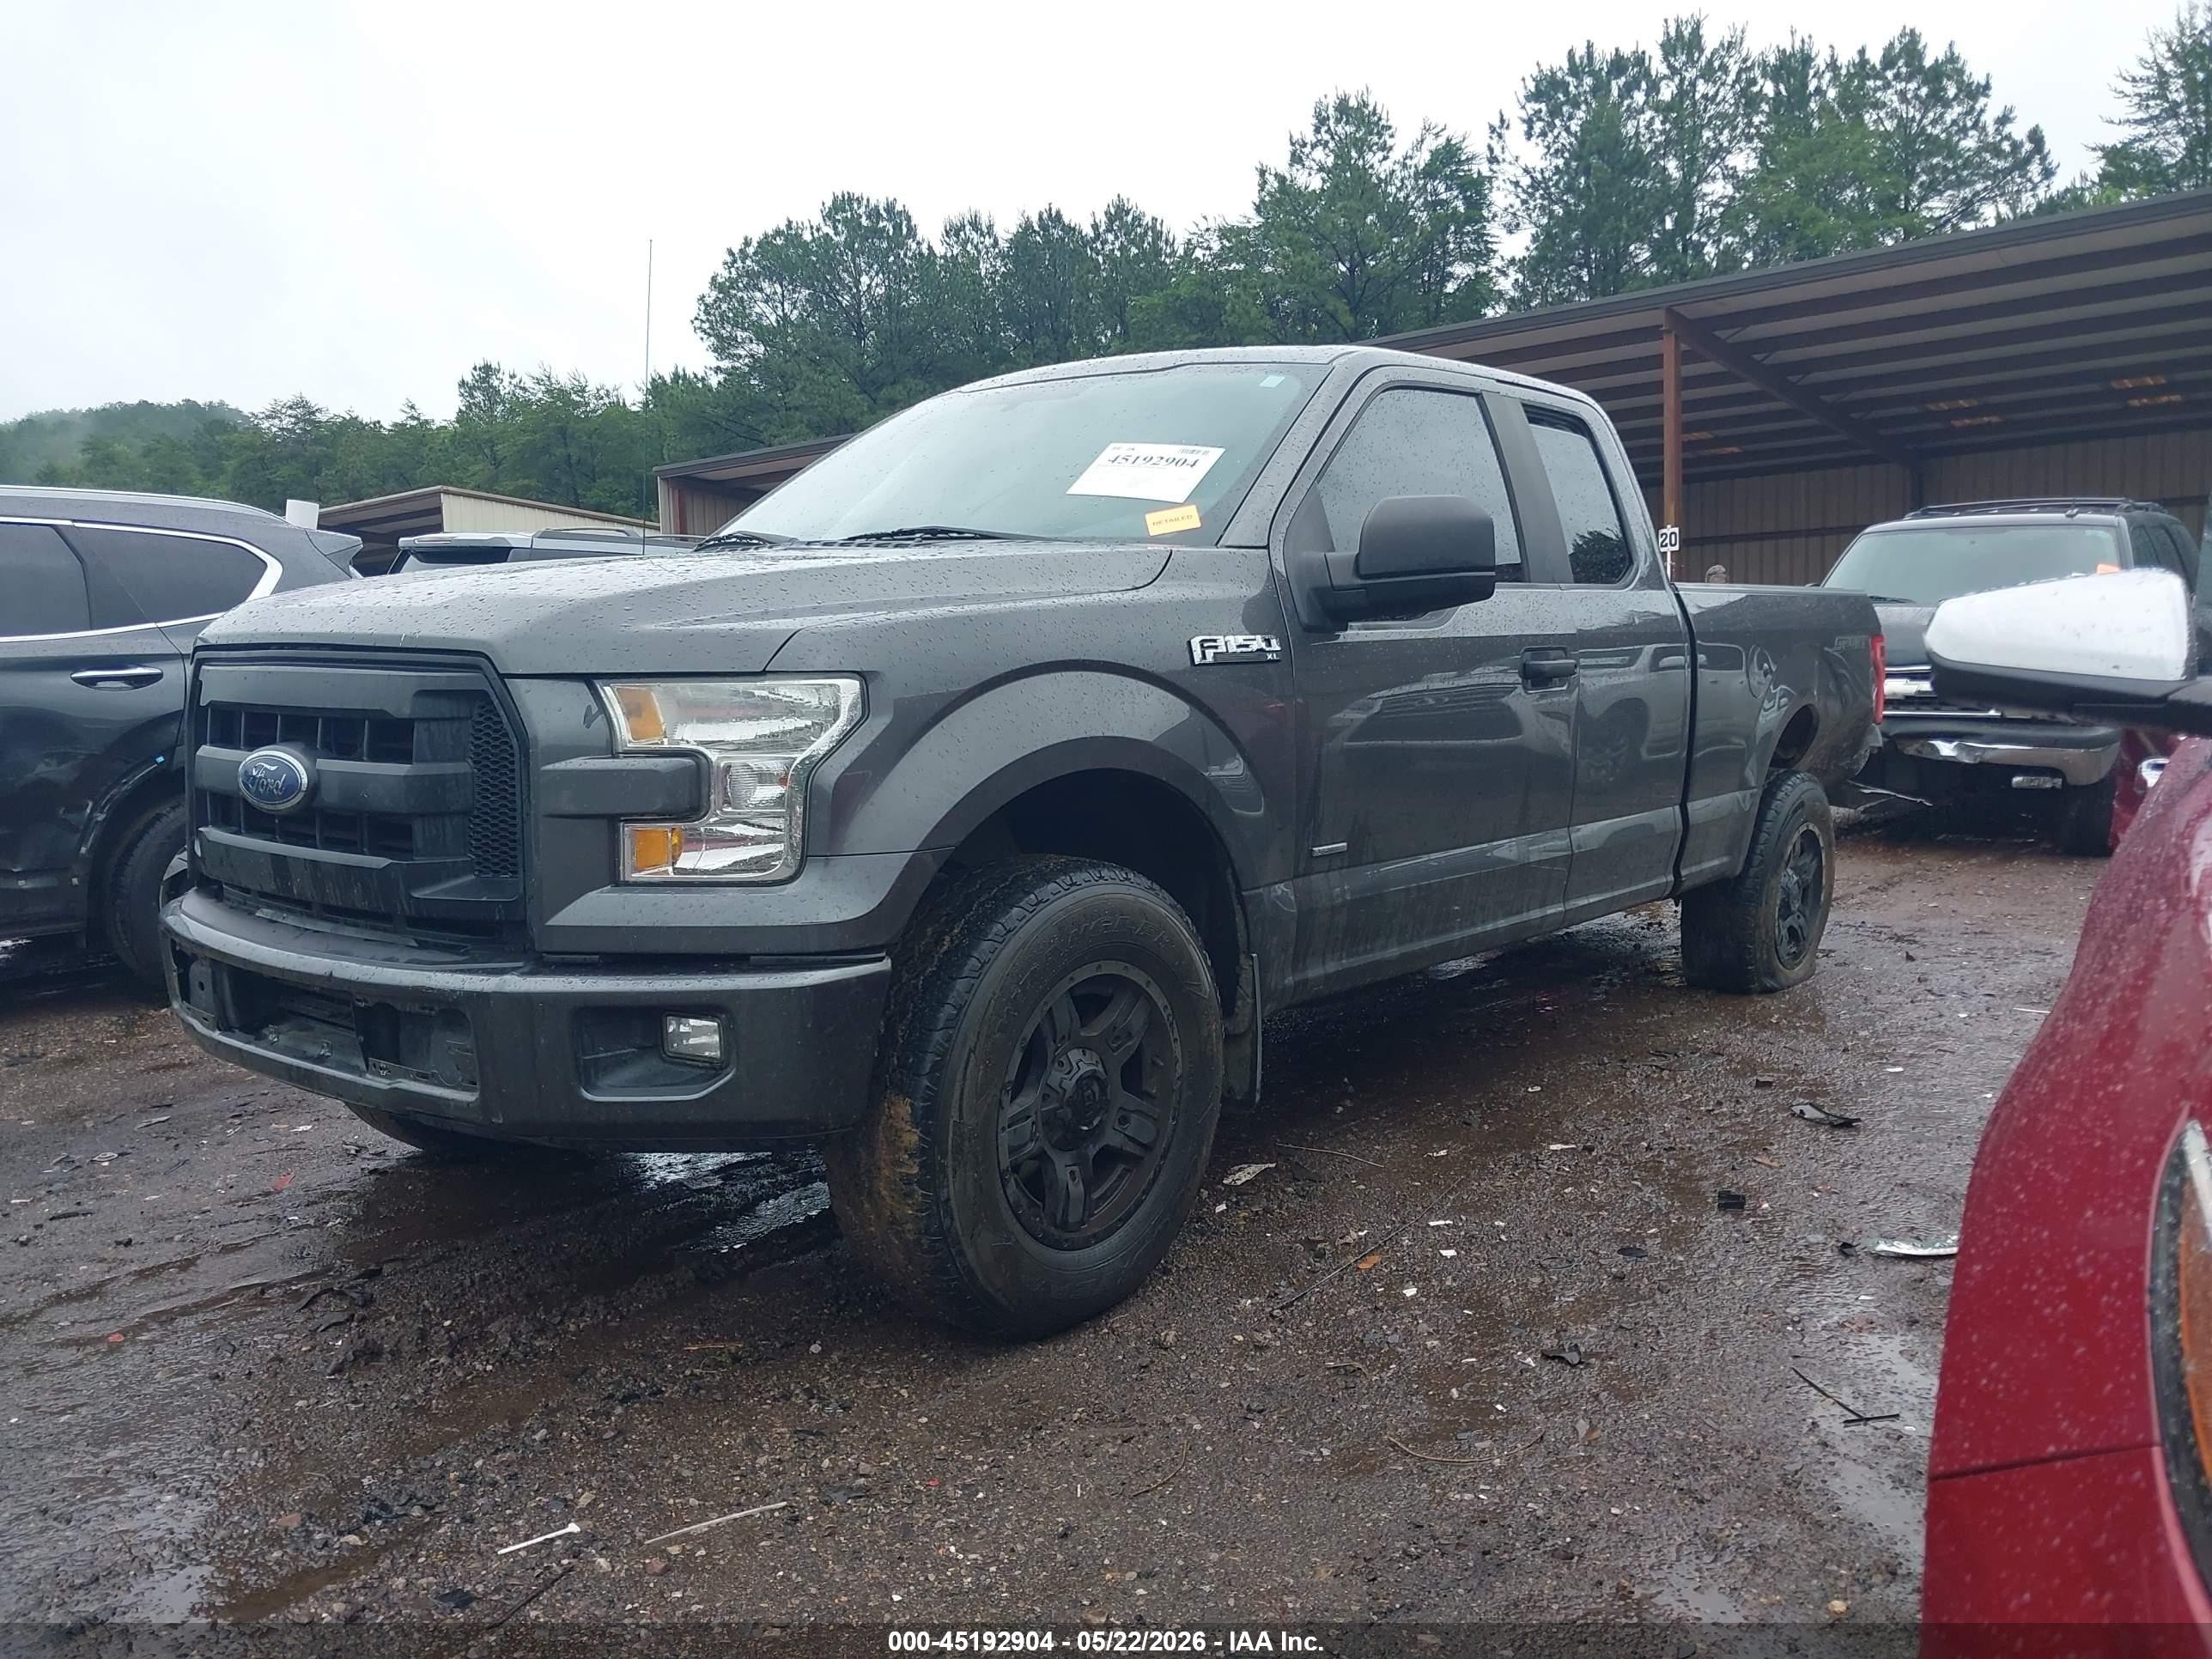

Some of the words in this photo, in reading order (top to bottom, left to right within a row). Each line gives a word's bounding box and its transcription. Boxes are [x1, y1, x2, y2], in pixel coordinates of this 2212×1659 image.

[1108, 455, 1200, 467] 45192904
[1660, 531, 1678, 549] 20
[244, 762, 288, 795] Ford
